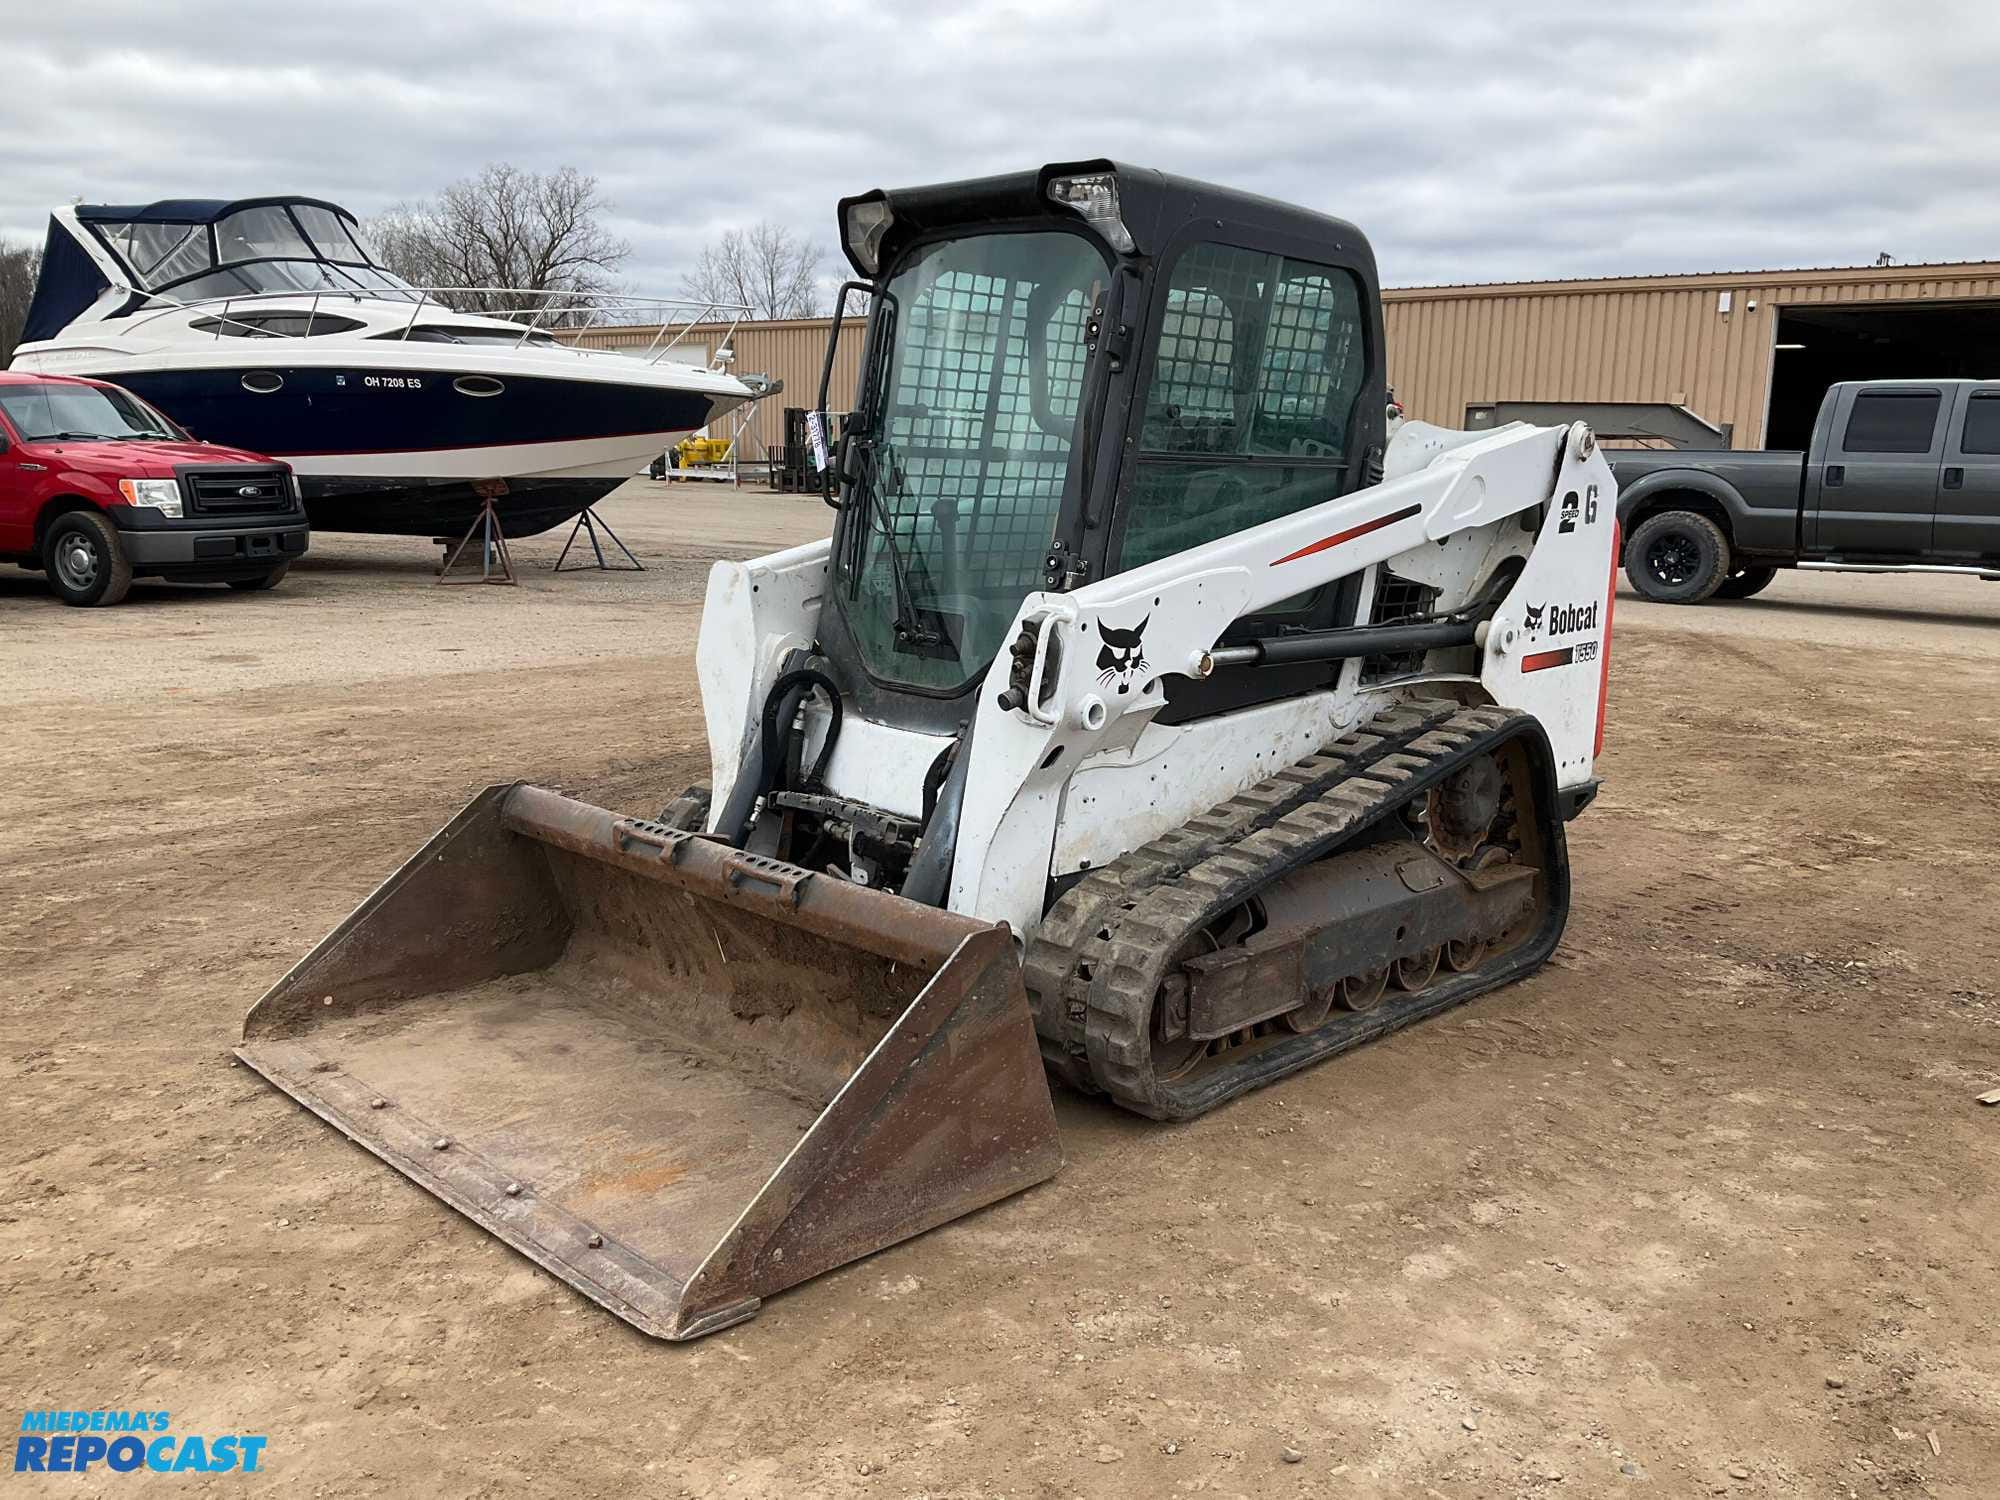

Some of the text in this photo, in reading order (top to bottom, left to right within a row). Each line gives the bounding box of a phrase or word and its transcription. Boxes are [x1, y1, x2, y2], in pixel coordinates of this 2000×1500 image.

[364, 376, 422, 388] OH 7208 ES
[1558, 491, 1579, 534] 2
[1560, 509, 1580, 519] SPEED
[1549, 600, 1598, 636] Bobcat
[1574, 640, 1599, 664] T550
